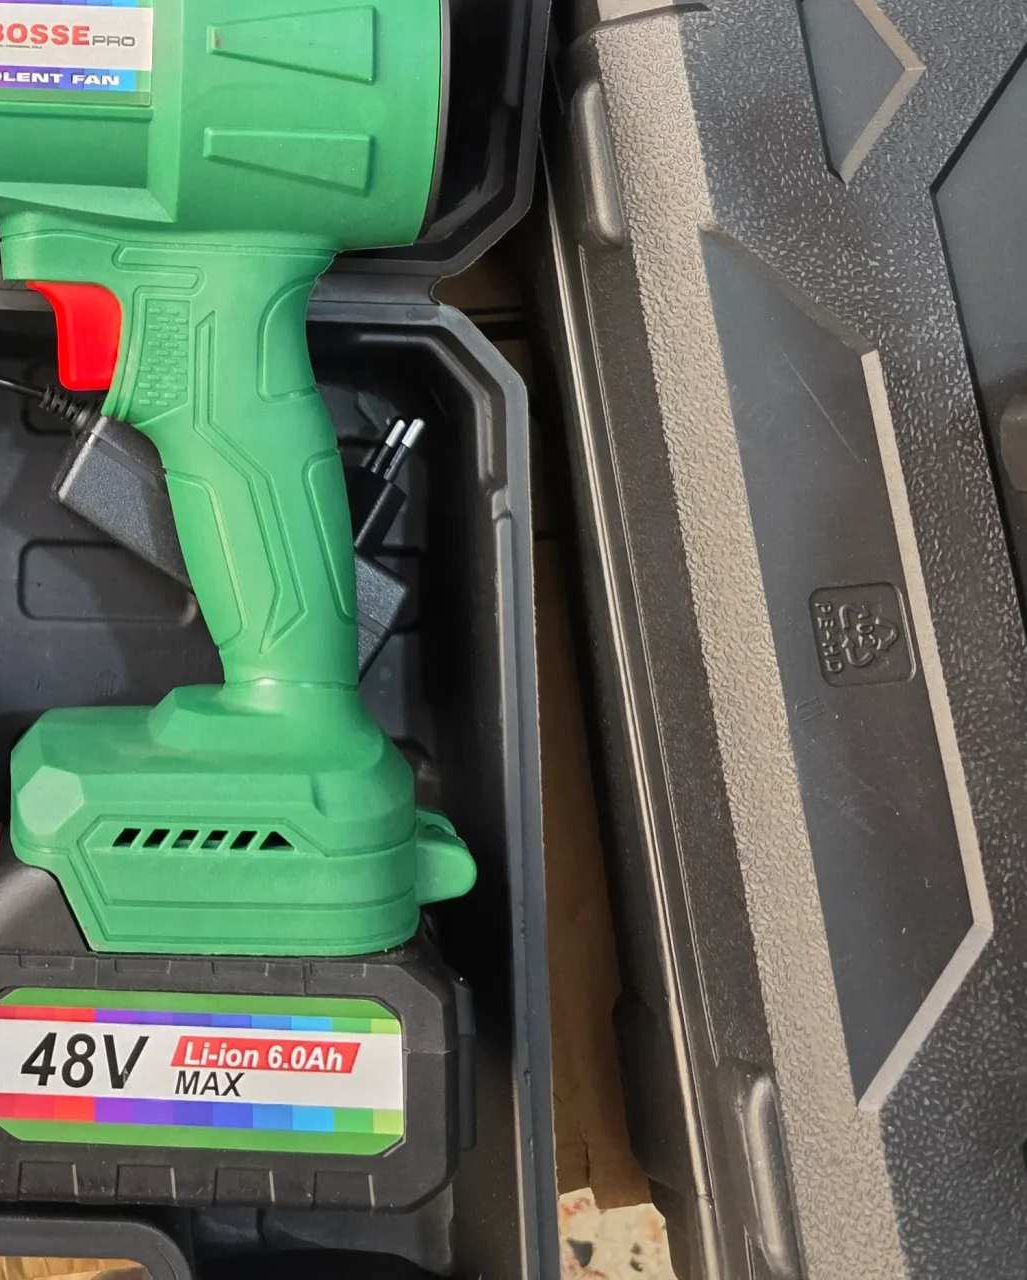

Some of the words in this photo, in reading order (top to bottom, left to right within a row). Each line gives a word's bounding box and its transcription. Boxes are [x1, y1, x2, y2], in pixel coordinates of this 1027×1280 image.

[92, 35, 136, 47] PRO
[71, 74, 120, 86] FAN
[20, 1032, 149, 1089] 48V
[184, 1040, 259, 1069] Li-ion
[267, 1045, 344, 1072] 6.0Ah
[174, 1070, 245, 1097] MAX
